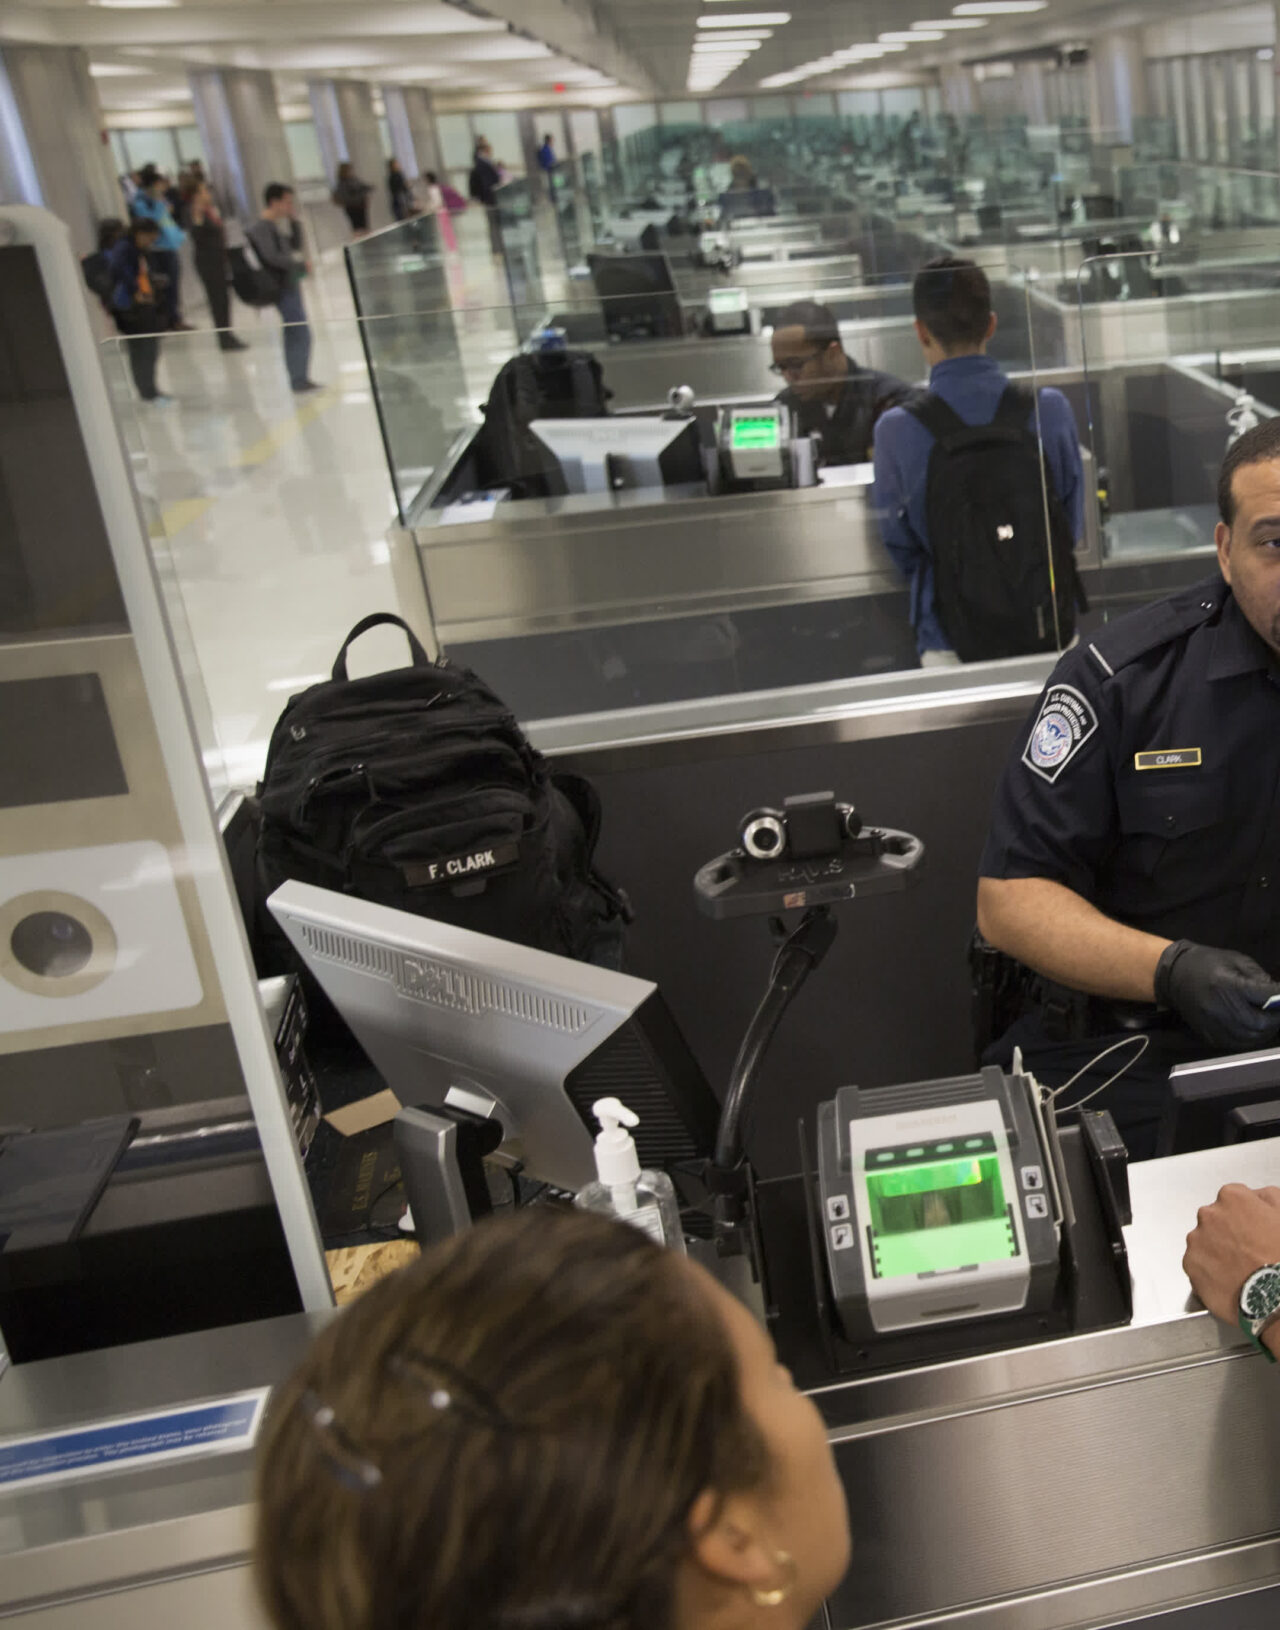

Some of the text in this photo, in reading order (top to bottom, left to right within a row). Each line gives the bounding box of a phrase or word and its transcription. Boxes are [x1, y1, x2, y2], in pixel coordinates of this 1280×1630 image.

[1060, 704, 1083, 740] PROTECTION
[1155, 754, 1183, 765] CLARK
[428, 849, 496, 880] F. CLARK
[778, 858, 845, 884] HAVS
